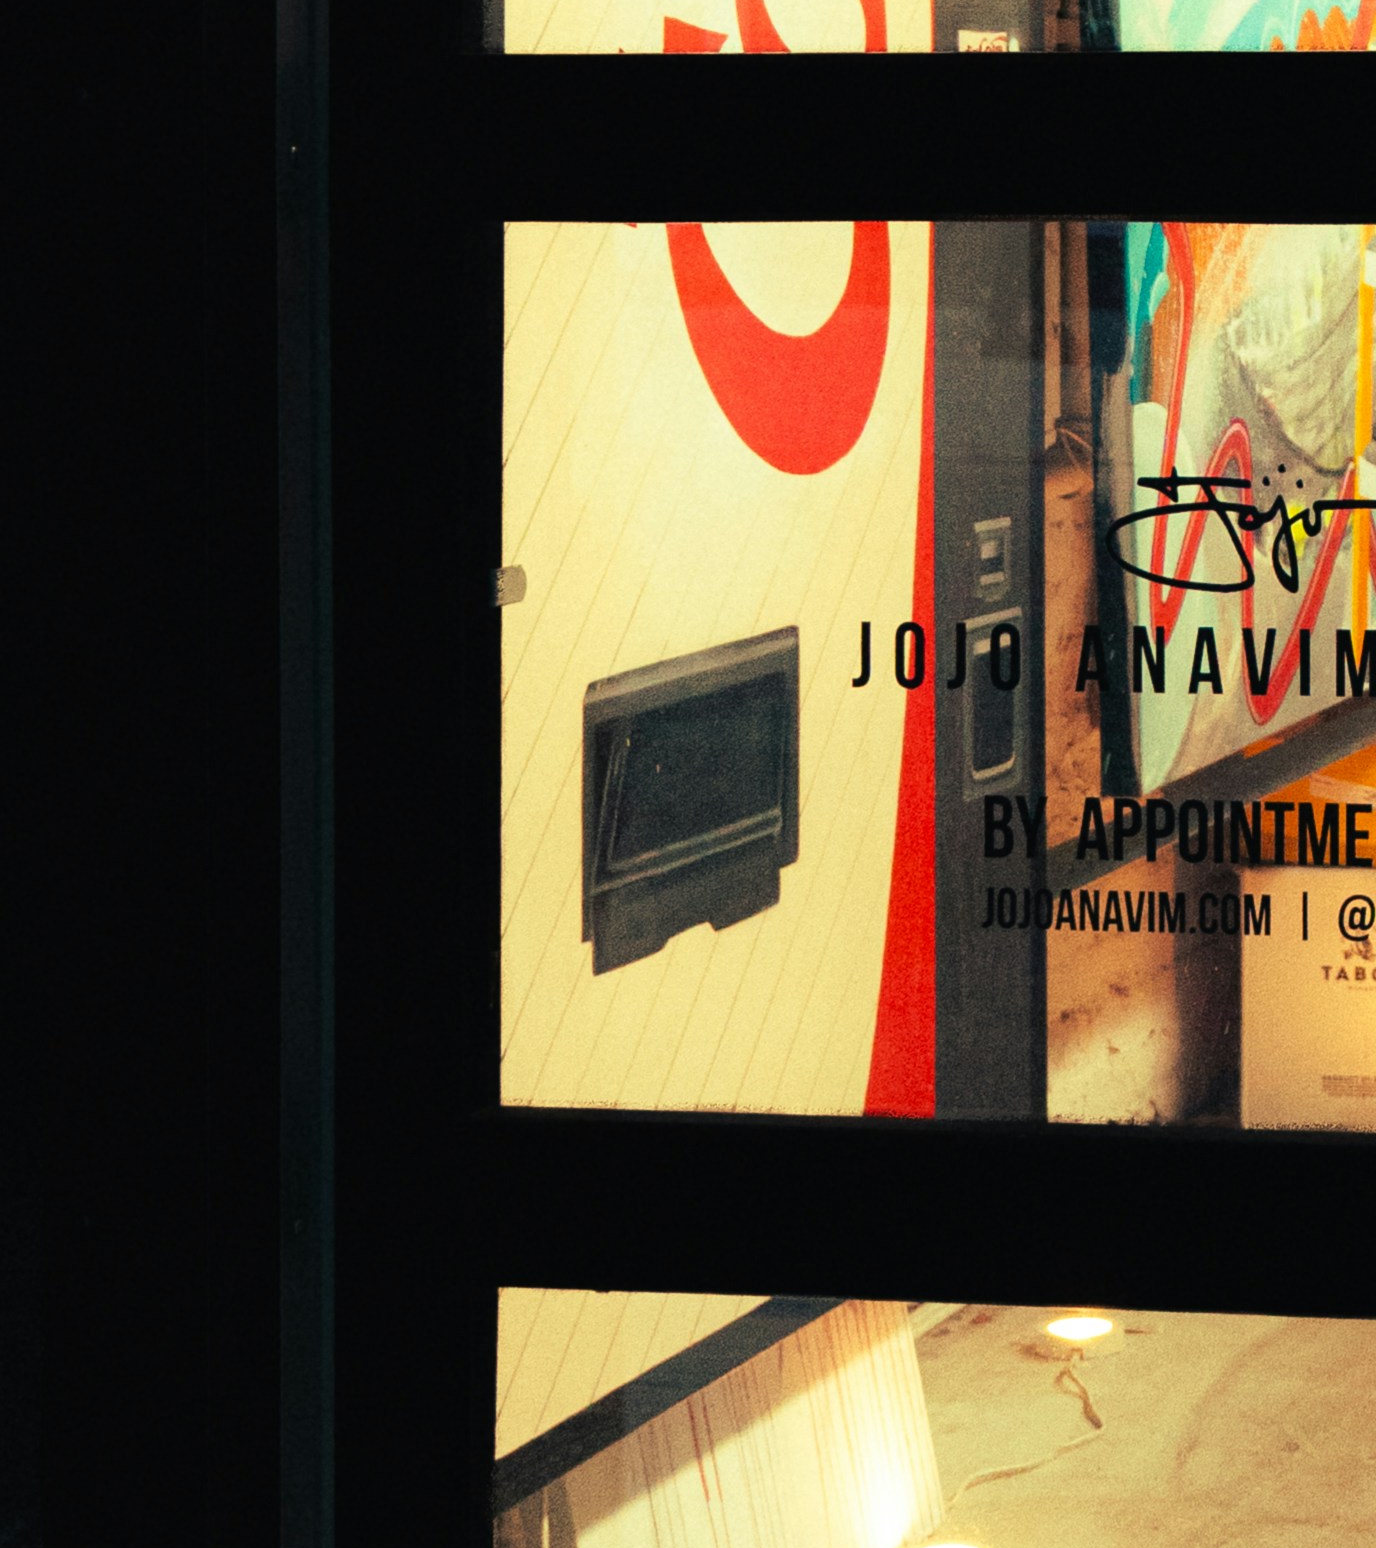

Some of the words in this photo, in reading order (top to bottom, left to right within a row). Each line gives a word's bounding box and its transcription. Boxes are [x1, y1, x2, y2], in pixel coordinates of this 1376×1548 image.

[851, 620, 1023, 689] JOJO
[983, 795, 1047, 859] BY
[981, 886, 1272, 938] JOJOANAVIM.COM
